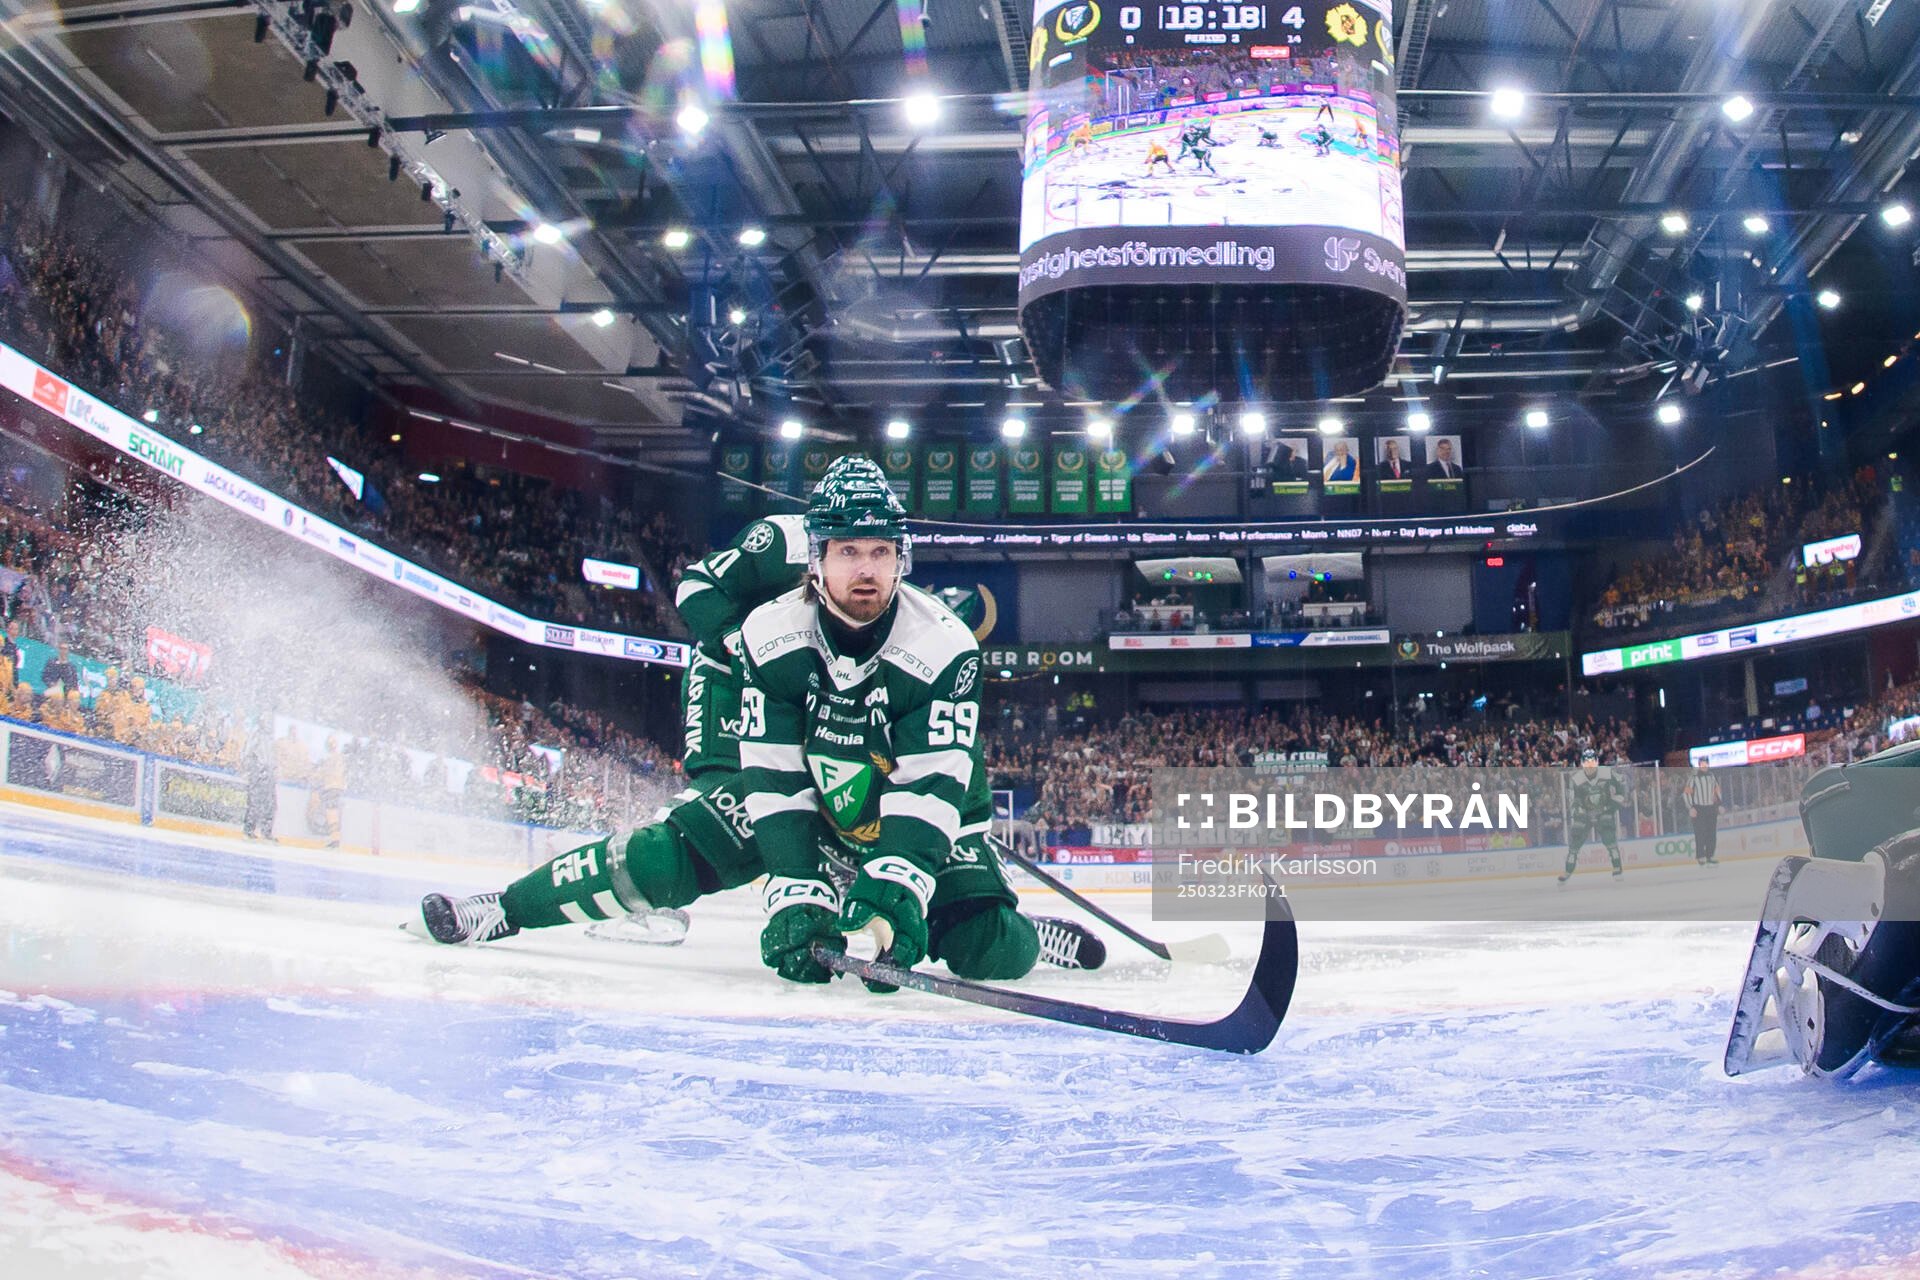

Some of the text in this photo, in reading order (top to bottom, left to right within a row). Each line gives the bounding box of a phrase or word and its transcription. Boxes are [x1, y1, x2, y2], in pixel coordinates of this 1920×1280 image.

[1119, 6, 1142, 30] 0
[1281, 6, 1305, 30] 4
[1018, 241, 1275, 291] astighetsförmedling
[127, 432, 185, 476] SCHAKT
[1027, 651, 1093, 666] ROOM
[1426, 641, 1516, 655] The Wolfpack
[1630, 643, 1673, 666] print
[741, 687, 766, 737] 59
[828, 694, 856, 706] CCM
[720, 716, 742, 736] vo
[928, 699, 979, 748] 59
[1749, 738, 1801, 756] CCM
[820, 760, 839, 790] F
[833, 785, 856, 813] BK
[768, 883, 835, 909] CCM
